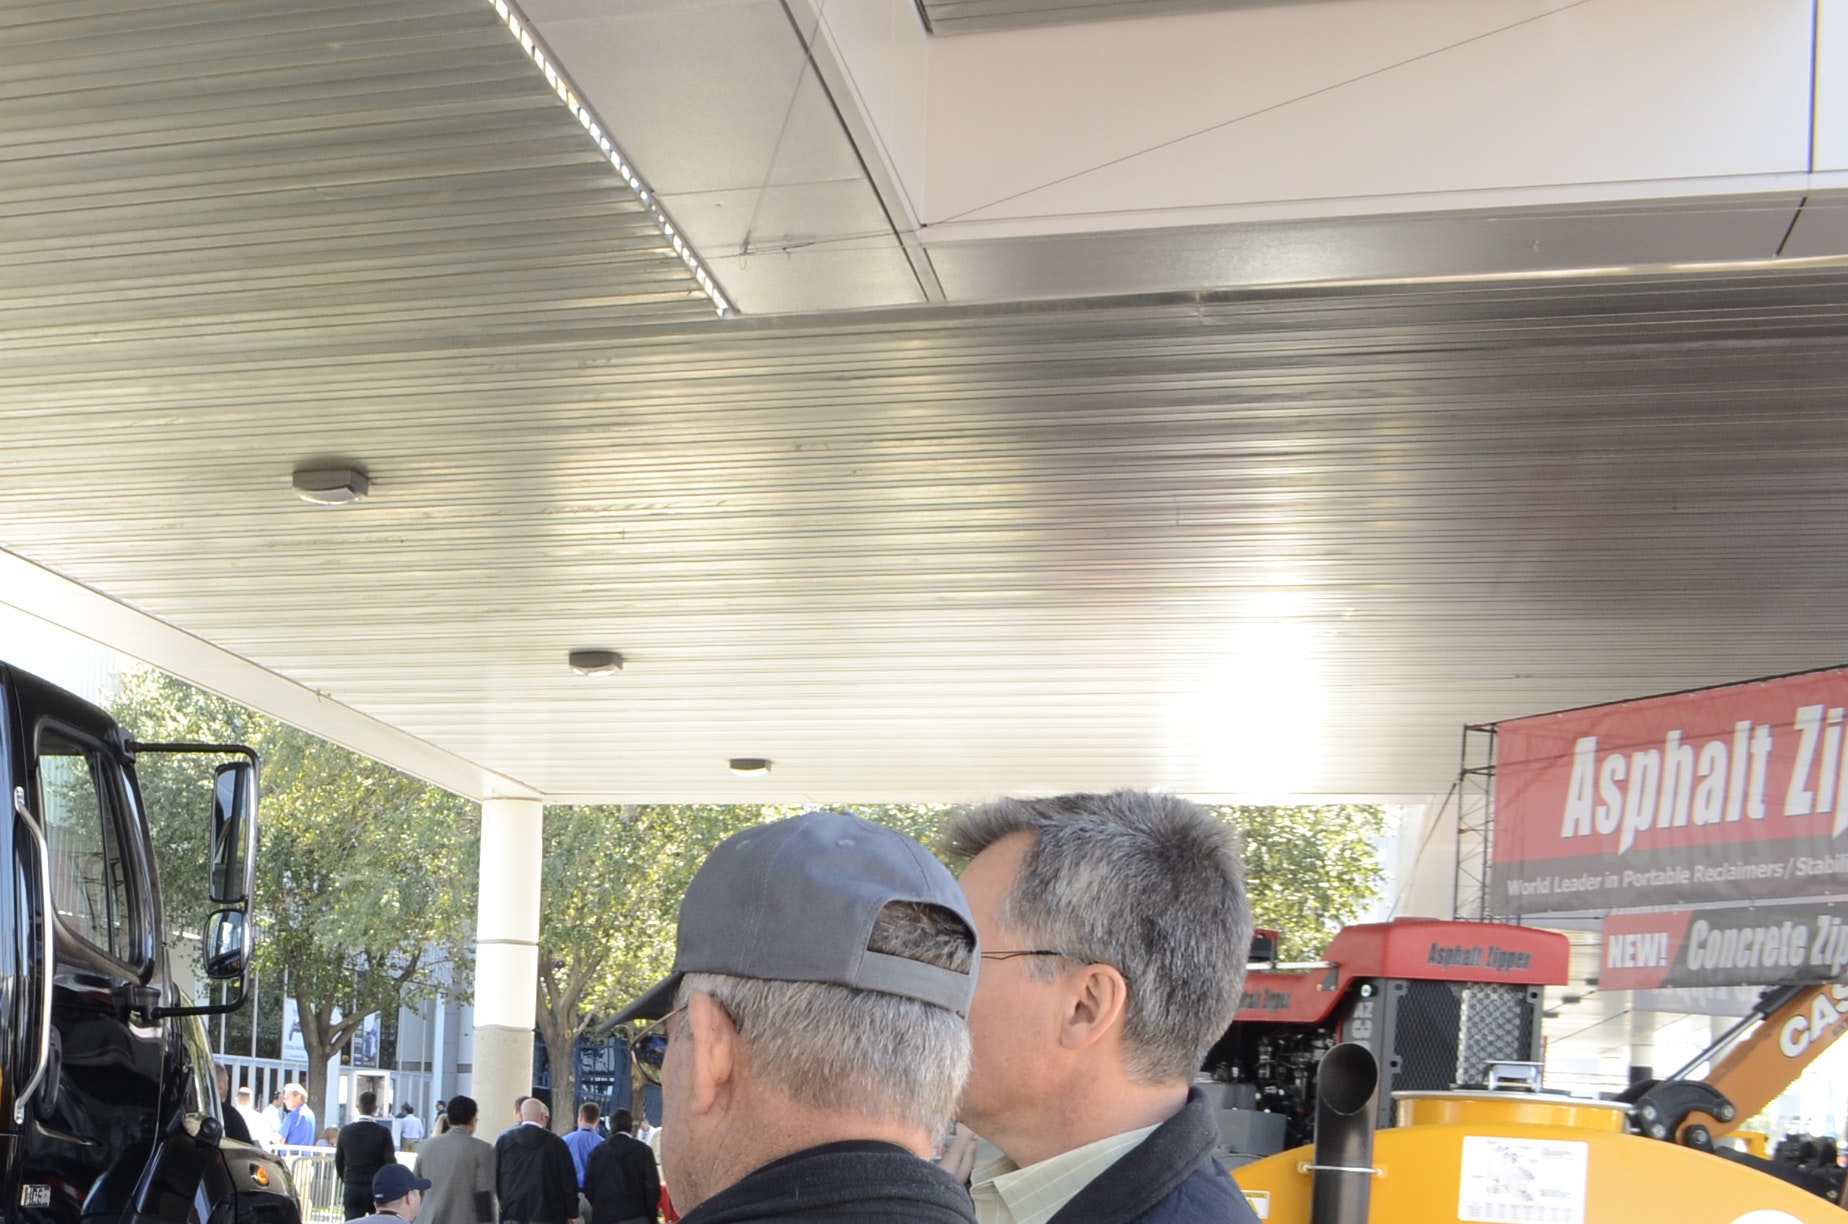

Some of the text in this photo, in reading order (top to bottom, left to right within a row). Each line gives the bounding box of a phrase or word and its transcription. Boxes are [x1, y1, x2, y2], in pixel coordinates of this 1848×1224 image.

[1560, 720, 1774, 856] Asphalt
[1507, 878, 1550, 897] World
[1553, 875, 1601, 892] Leader
[1604, 872, 1619, 888] in
[1623, 866, 1689, 887] Portable
[1694, 860, 1784, 882] Reclaimers
[1427, 942, 1533, 972] Asphalt Zipper
[1607, 932, 1669, 969] NEW!
[1686, 919, 1809, 970] Concrete
